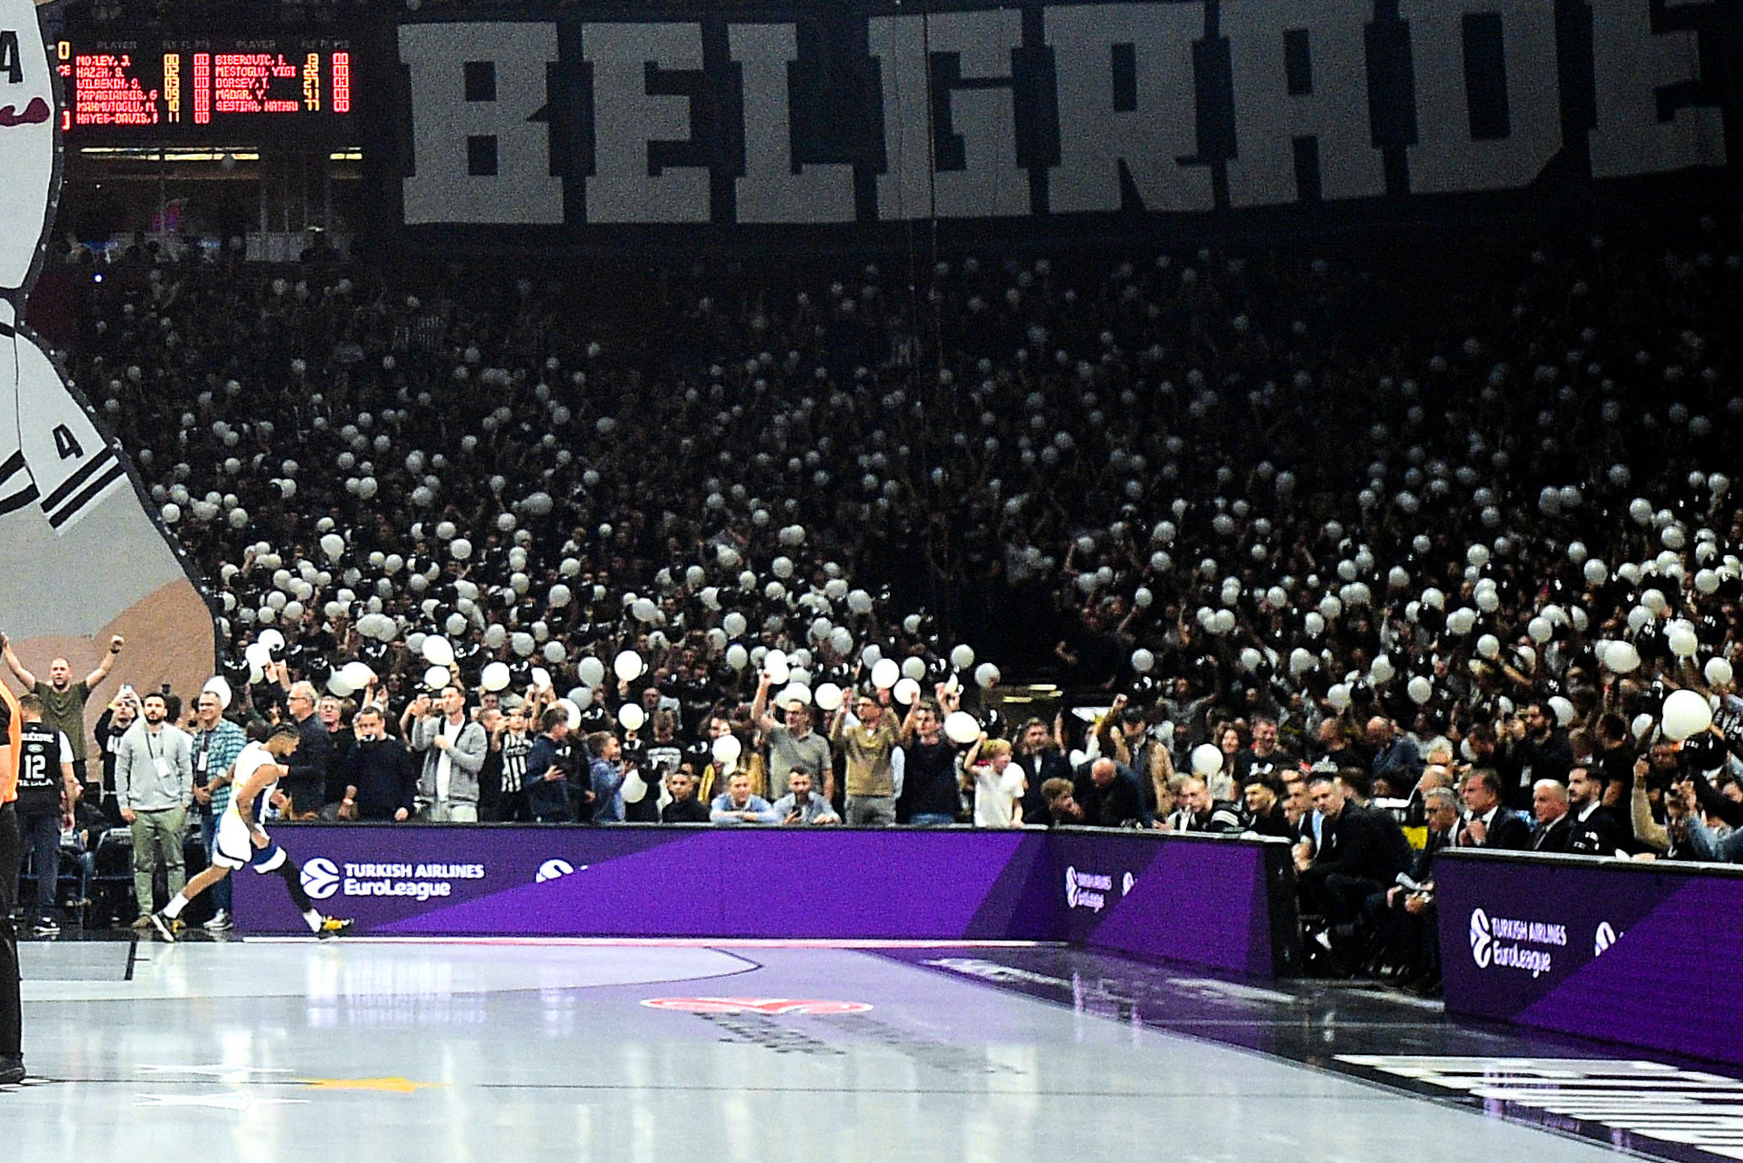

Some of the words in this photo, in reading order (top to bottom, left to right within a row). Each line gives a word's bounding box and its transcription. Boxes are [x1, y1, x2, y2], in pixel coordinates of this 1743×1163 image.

[215, 77, 259, 89] DORSEY,
[52, 424, 84, 460] 4
[24, 754, 46, 779] 12
[344, 863, 413, 877] TURKISH
[415, 864, 485, 878] AIRLINES
[344, 878, 451, 901] EuroLeague
[1491, 917, 1528, 941] TURKISH
[1528, 922, 1567, 946] AIRLINES
[1492, 940, 1551, 978] EuroLeague
